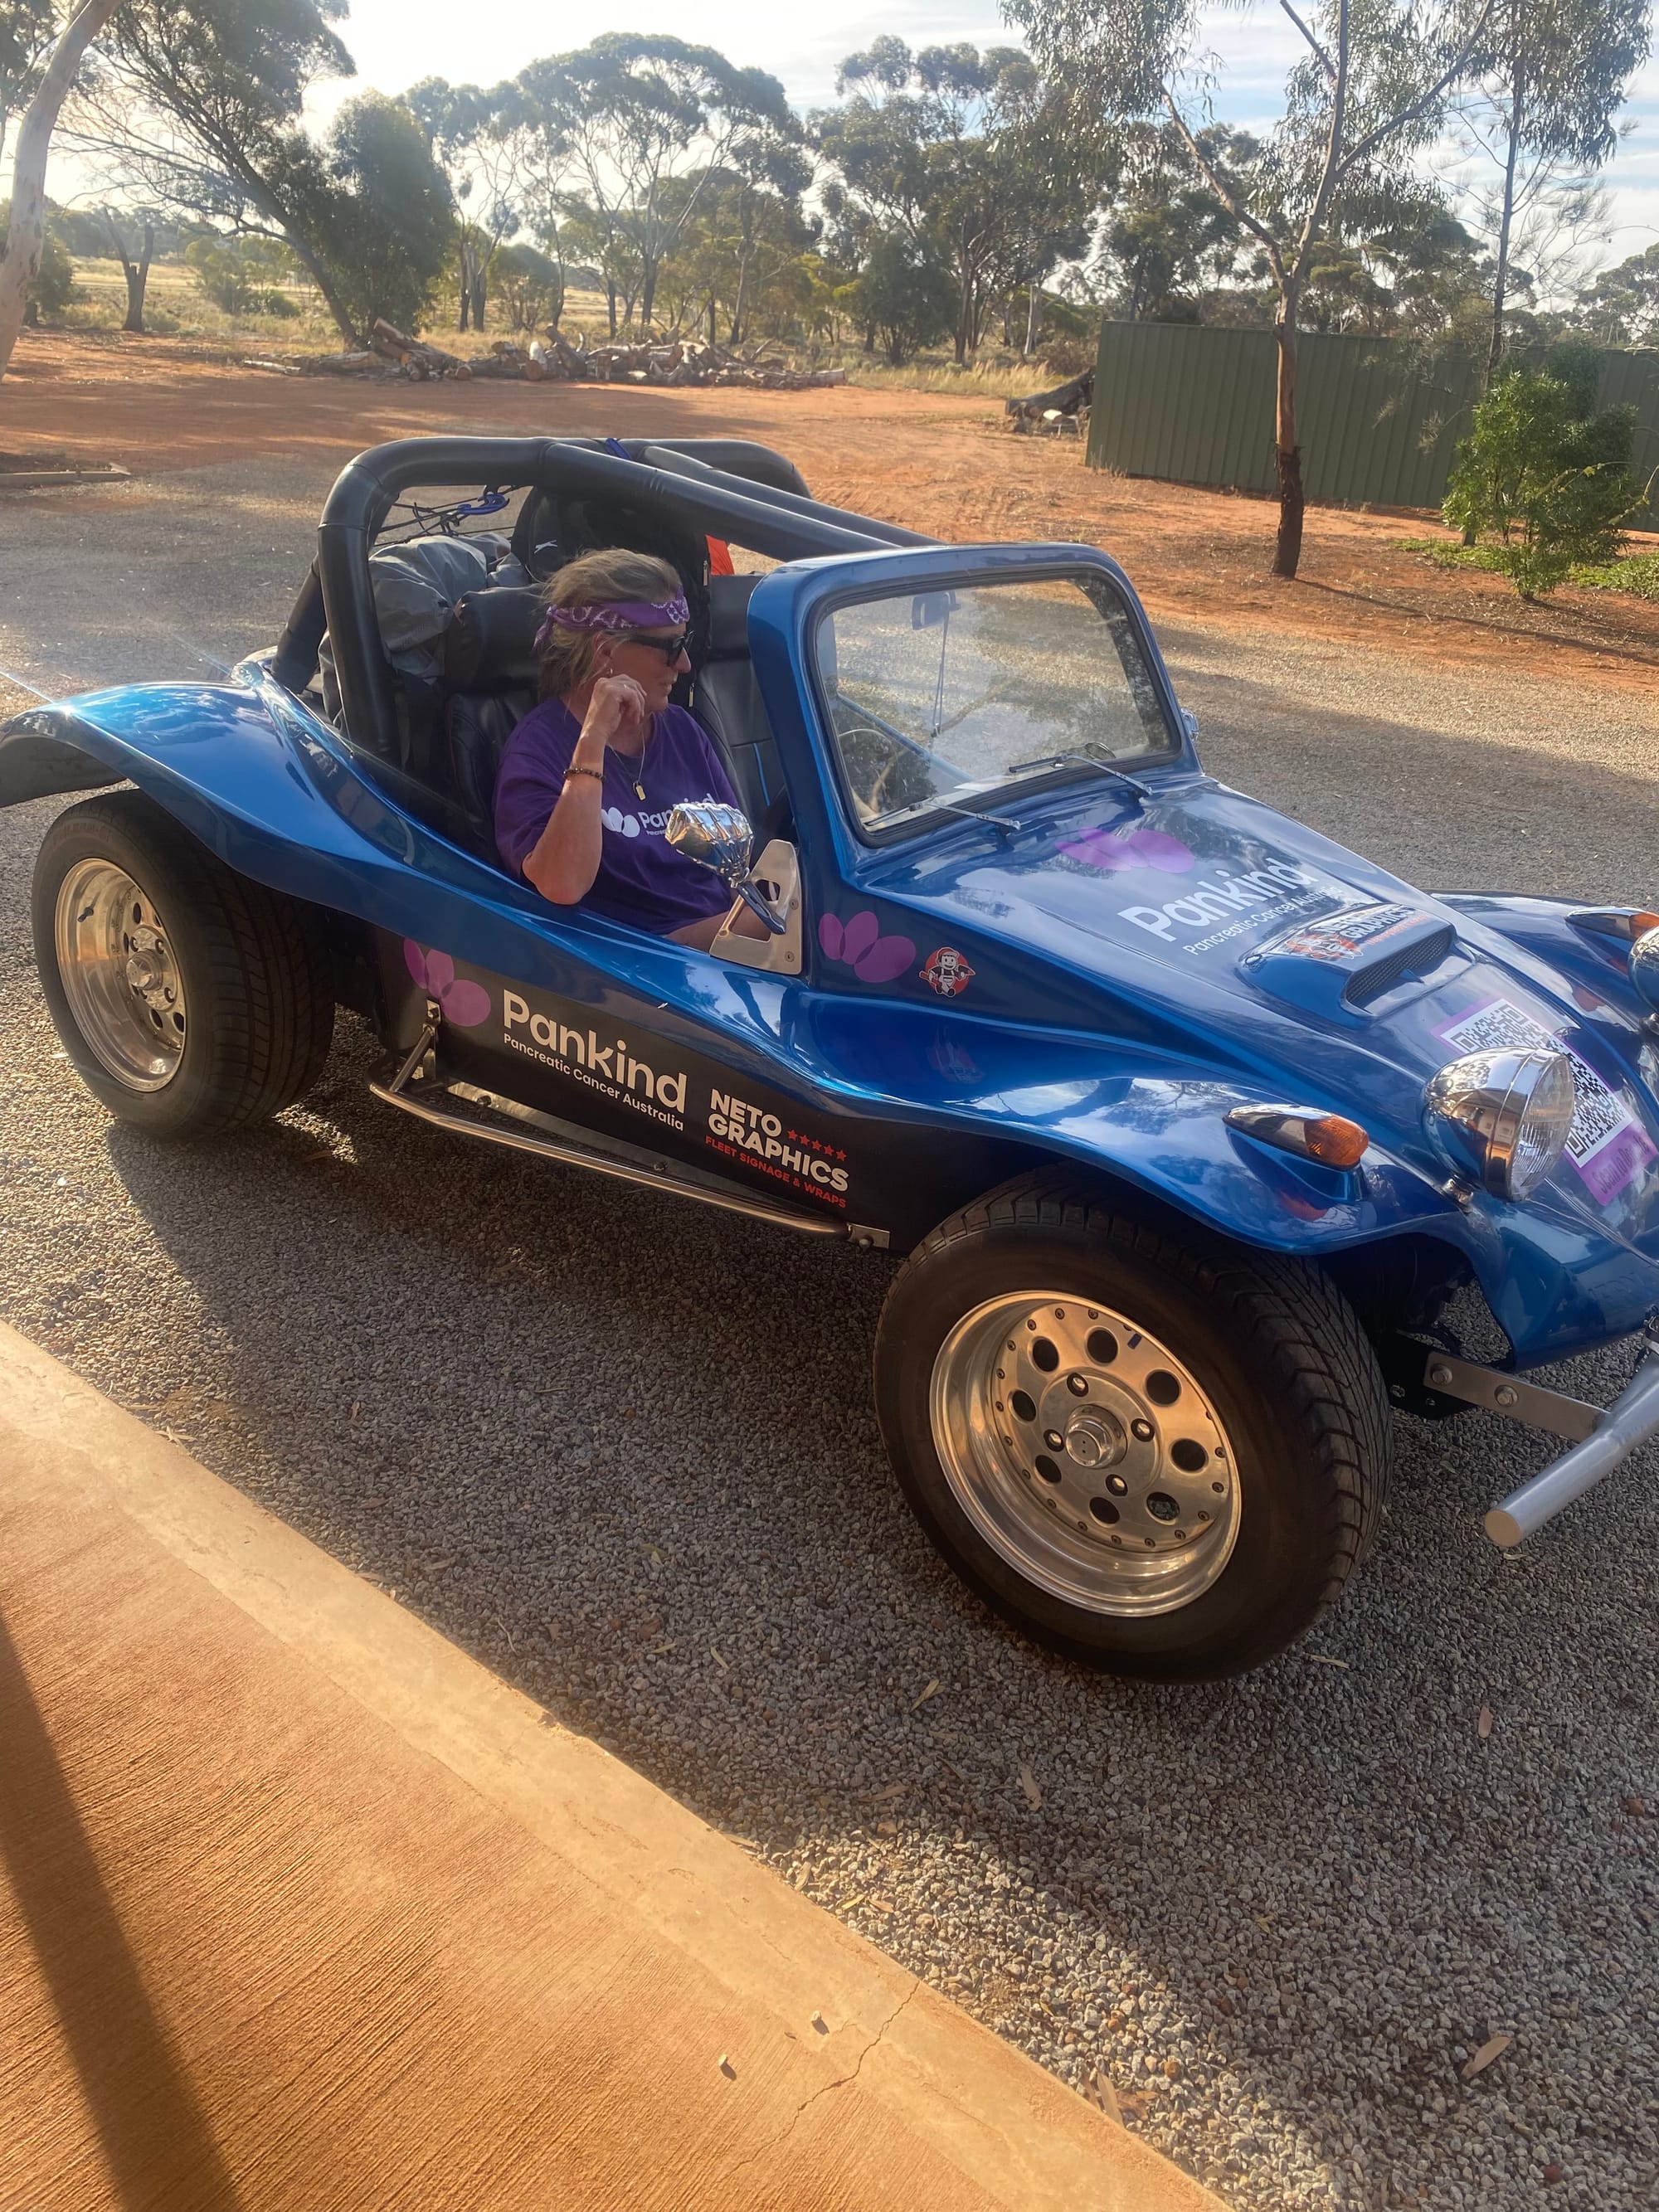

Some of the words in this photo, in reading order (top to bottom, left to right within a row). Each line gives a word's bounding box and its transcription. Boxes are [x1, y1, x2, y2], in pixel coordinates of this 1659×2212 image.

[1117, 857, 1319, 942] Pankind
[1182, 916, 1258, 955] Pancreatic
[1250, 902, 1299, 923] Cancer
[1339, 905, 1414, 939] GRAPHICS
[504, 989, 688, 1114] Pankind
[504, 1033, 571, 1075] Pancreatic
[573, 1068, 620, 1099] Cancer
[622, 1093, 684, 1131] Australia
[710, 1088, 782, 1137] NETO
[705, 1135, 737, 1158] FLEET
[739, 1152, 791, 1183] SIGNAGE
[793, 1177, 800, 1188] &
[804, 1181, 847, 1208] WRAPS
[708, 1113, 849, 1192] GRAPHICS
